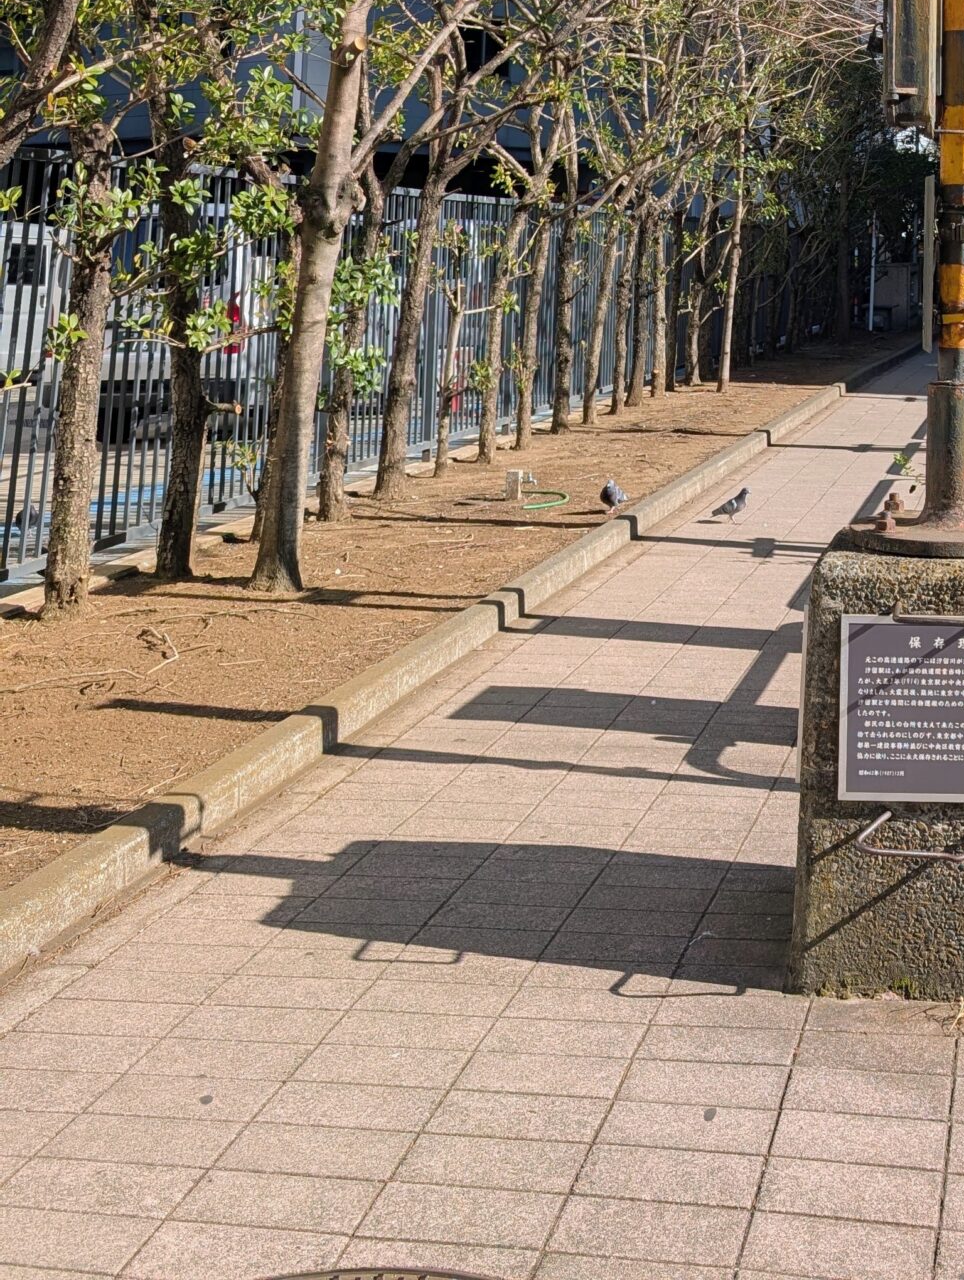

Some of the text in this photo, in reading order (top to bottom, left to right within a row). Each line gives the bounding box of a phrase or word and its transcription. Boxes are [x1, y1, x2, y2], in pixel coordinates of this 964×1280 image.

[857, 709, 891, 717] したのです。
